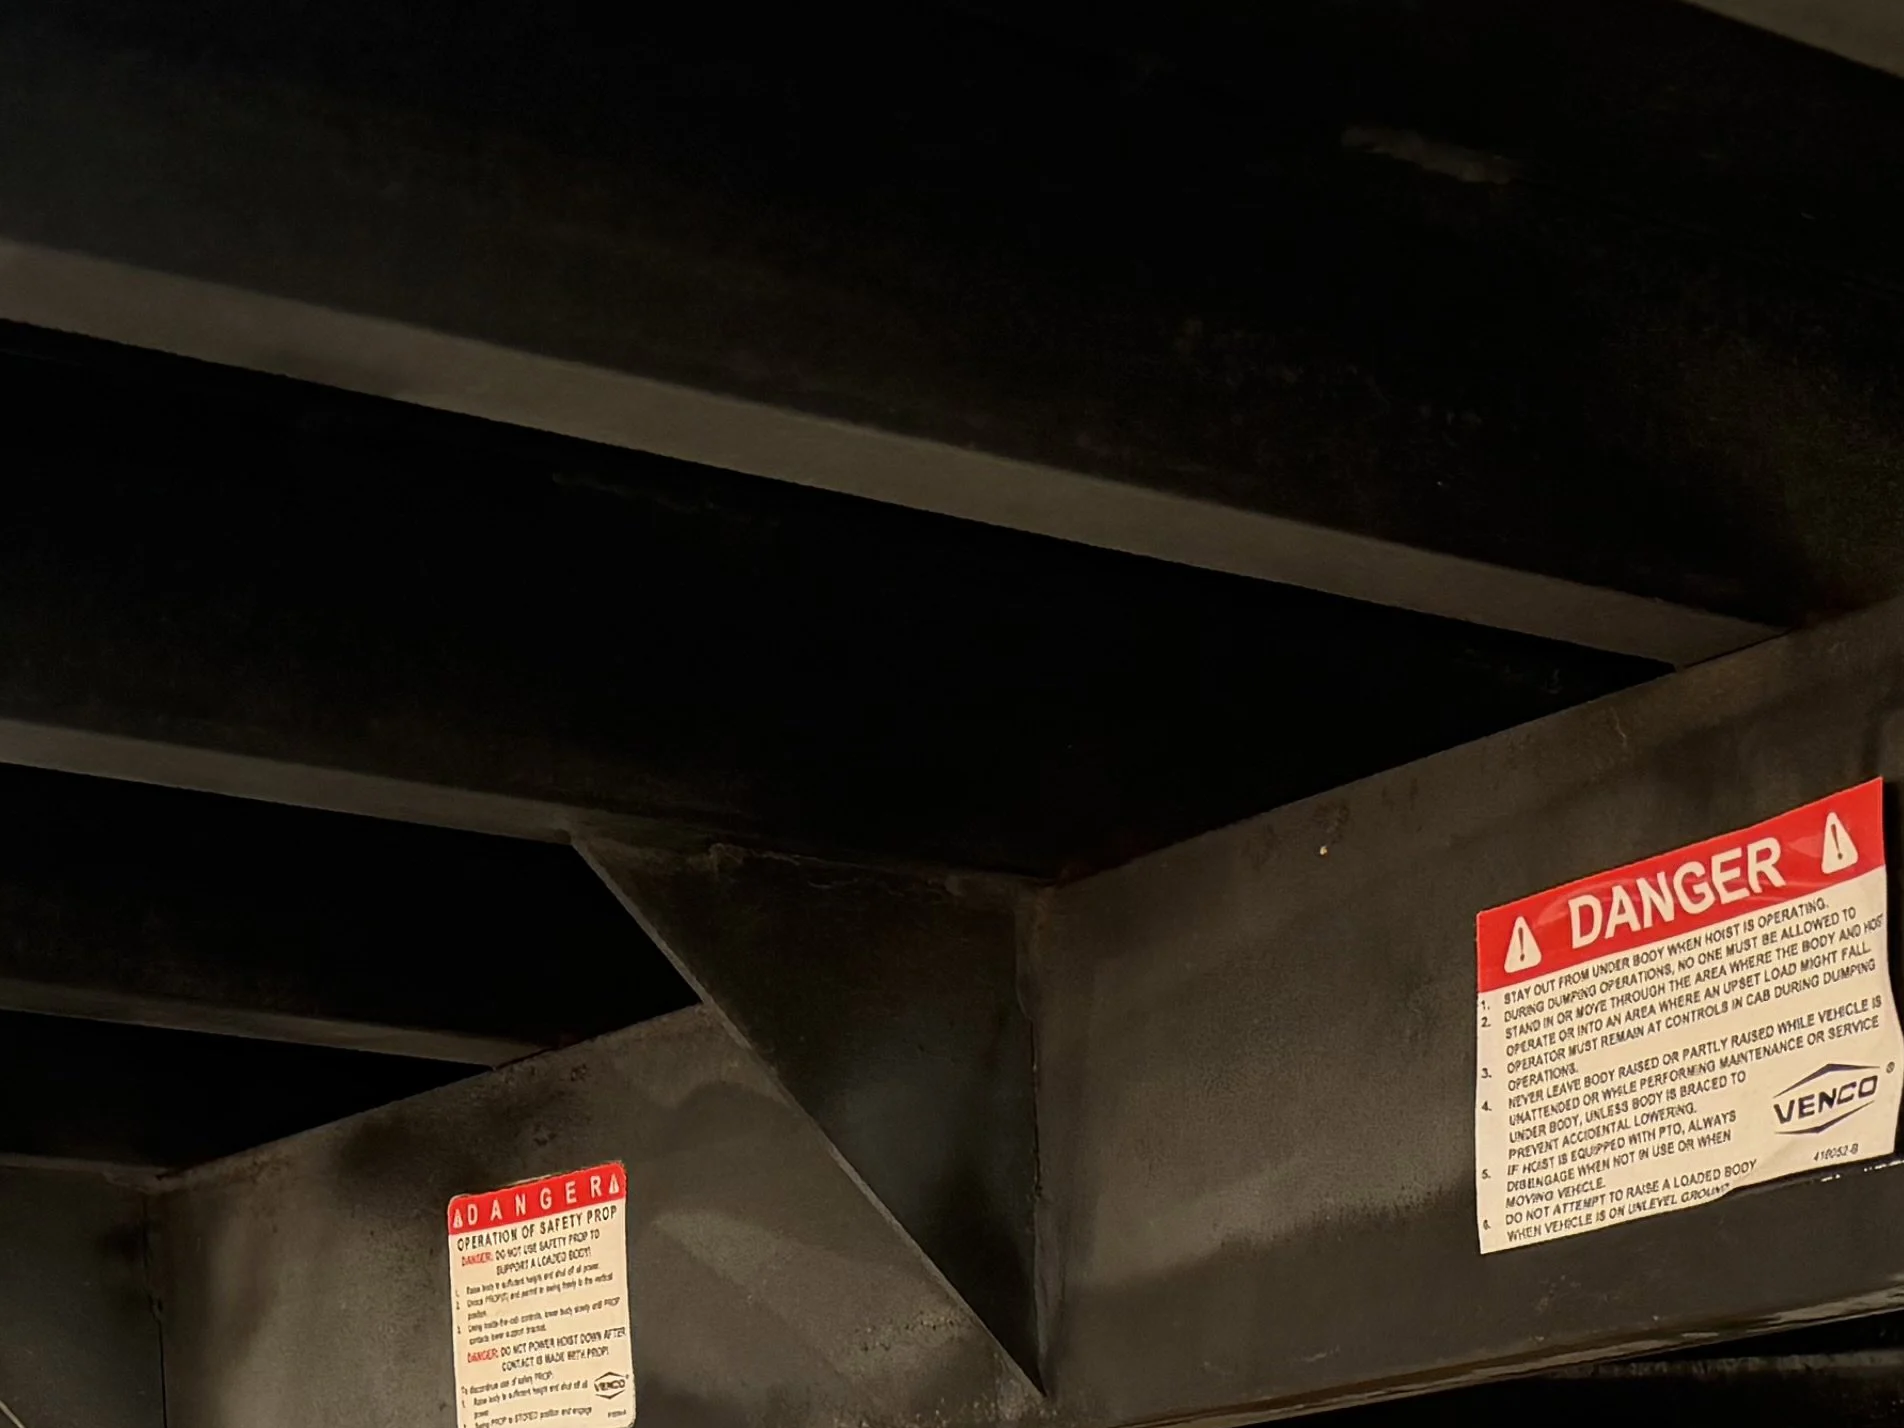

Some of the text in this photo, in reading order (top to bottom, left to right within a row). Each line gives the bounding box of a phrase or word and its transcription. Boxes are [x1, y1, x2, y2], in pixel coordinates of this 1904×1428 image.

[1567, 837, 1786, 949] DANGER
[1480, 895, 1829, 1013] 1. STAY OUT FROM UNDER BODY WHEN HOIST IS OPERATING.
[1480, 1014, 1491, 1029] 2.
[1503, 999, 1544, 1023] DURING
[1547, 983, 1596, 1010] DUMPING
[1677, 954, 1694, 972] NO
[1697, 946, 1722, 966] ONE
[1725, 935, 1756, 957] MUST
[1761, 929, 1778, 947] BE
[1780, 911, 1839, 942] ALLOWED
[1844, 906, 1857, 924] TO
[1505, 1017, 1541, 1040] STAND
[1542, 1014, 1554, 1029] IN
[1556, 1008, 1573, 1025] OR
[1575, 997, 1607, 1020] MOVE
[1609, 981, 1665, 1010] THROUGH
[1668, 973, 1691, 993] THE
[1694, 963, 1727, 985] AREA
[1728, 949, 1772, 975] WHERE
[1776, 941, 1798, 961] THE
[1801, 931, 1834, 953] BODY
[1838, 922, 1861, 942] AND
[1480, 957, 1875, 1080] 3. OPERATOR MUST REMAIN AT CONTROLS IN CAB DURING DUMPING
[1505, 1031, 1556, 1058] OPERATE
[1558, 1025, 1575, 1043] OR
[1576, 1017, 1603, 1037] INTO
[1605, 1012, 1621, 1029] AN
[1624, 1002, 1656, 1023] AREA
[1658, 989, 1701, 1014] WHERE
[1703, 983, 1720, 1001] AN
[1723, 972, 1759, 995] UPSET
[1764, 960, 1797, 983] LOAD
[1800, 949, 1836, 973] MIGHT
[1480, 993, 1882, 1113] 4. NEVER LEAVE BODY RAISED OR PARTLY RAISED WHILE VEHICLE IS
[1582, 1089, 1599, 1107] OR
[1600, 1080, 1637, 1101] WHILE
[1806, 1028, 1825, 1047] OR
[1827, 1014, 1879, 1041] SERVICE
[1508, 1068, 1746, 1145] UNDER BODY, UNLESS BODY IS BRACED TO
[1561, 1117, 1631, 1147] ACCIDENTAL
[1773, 1074, 1878, 1124] VENCO
[1506, 1162, 1519, 1176] IF
[1522, 1155, 1554, 1175] HOIST
[1557, 1151, 1568, 1166] IS
[1570, 1136, 1625, 1162] EQUIPPED
[1628, 1127, 1656, 1146] WITH
[1658, 1120, 1685, 1139] PTO,
[1687, 1109, 1736, 1133] ALWAYS
[1576, 1157, 1610, 1177] WHEN
[1612, 1150, 1635, 1168] NOT
[1638, 1146, 1649, 1160] IN
[1652, 1140, 1674, 1158] USE
[1677, 1136, 1694, 1153] OR
[1696, 1128, 1731, 1148] WHEN
[457, 1203, 617, 1253] OPERATION OF SAFETY PROP
[1505, 1210, 1522, 1226] DO
[1525, 1204, 1550, 1222] NOT
[1552, 1193, 1606, 1216] ATTEMPT
[1608, 1188, 1623, 1203] TO
[1625, 1179, 1659, 1199] RAISE
[1661, 1177, 1671, 1191] A
[1673, 1166, 1721, 1190] LOADED
[1724, 1158, 1756, 1178] BODY
[1505, 1188, 1554, 1209] MOVING
[1506, 1223, 1541, 1243] WHEN
[1544, 1212, 1592, 1235] VEHICLE
[1595, 1208, 1606, 1223] IS
[1608, 1204, 1625, 1220] ON
